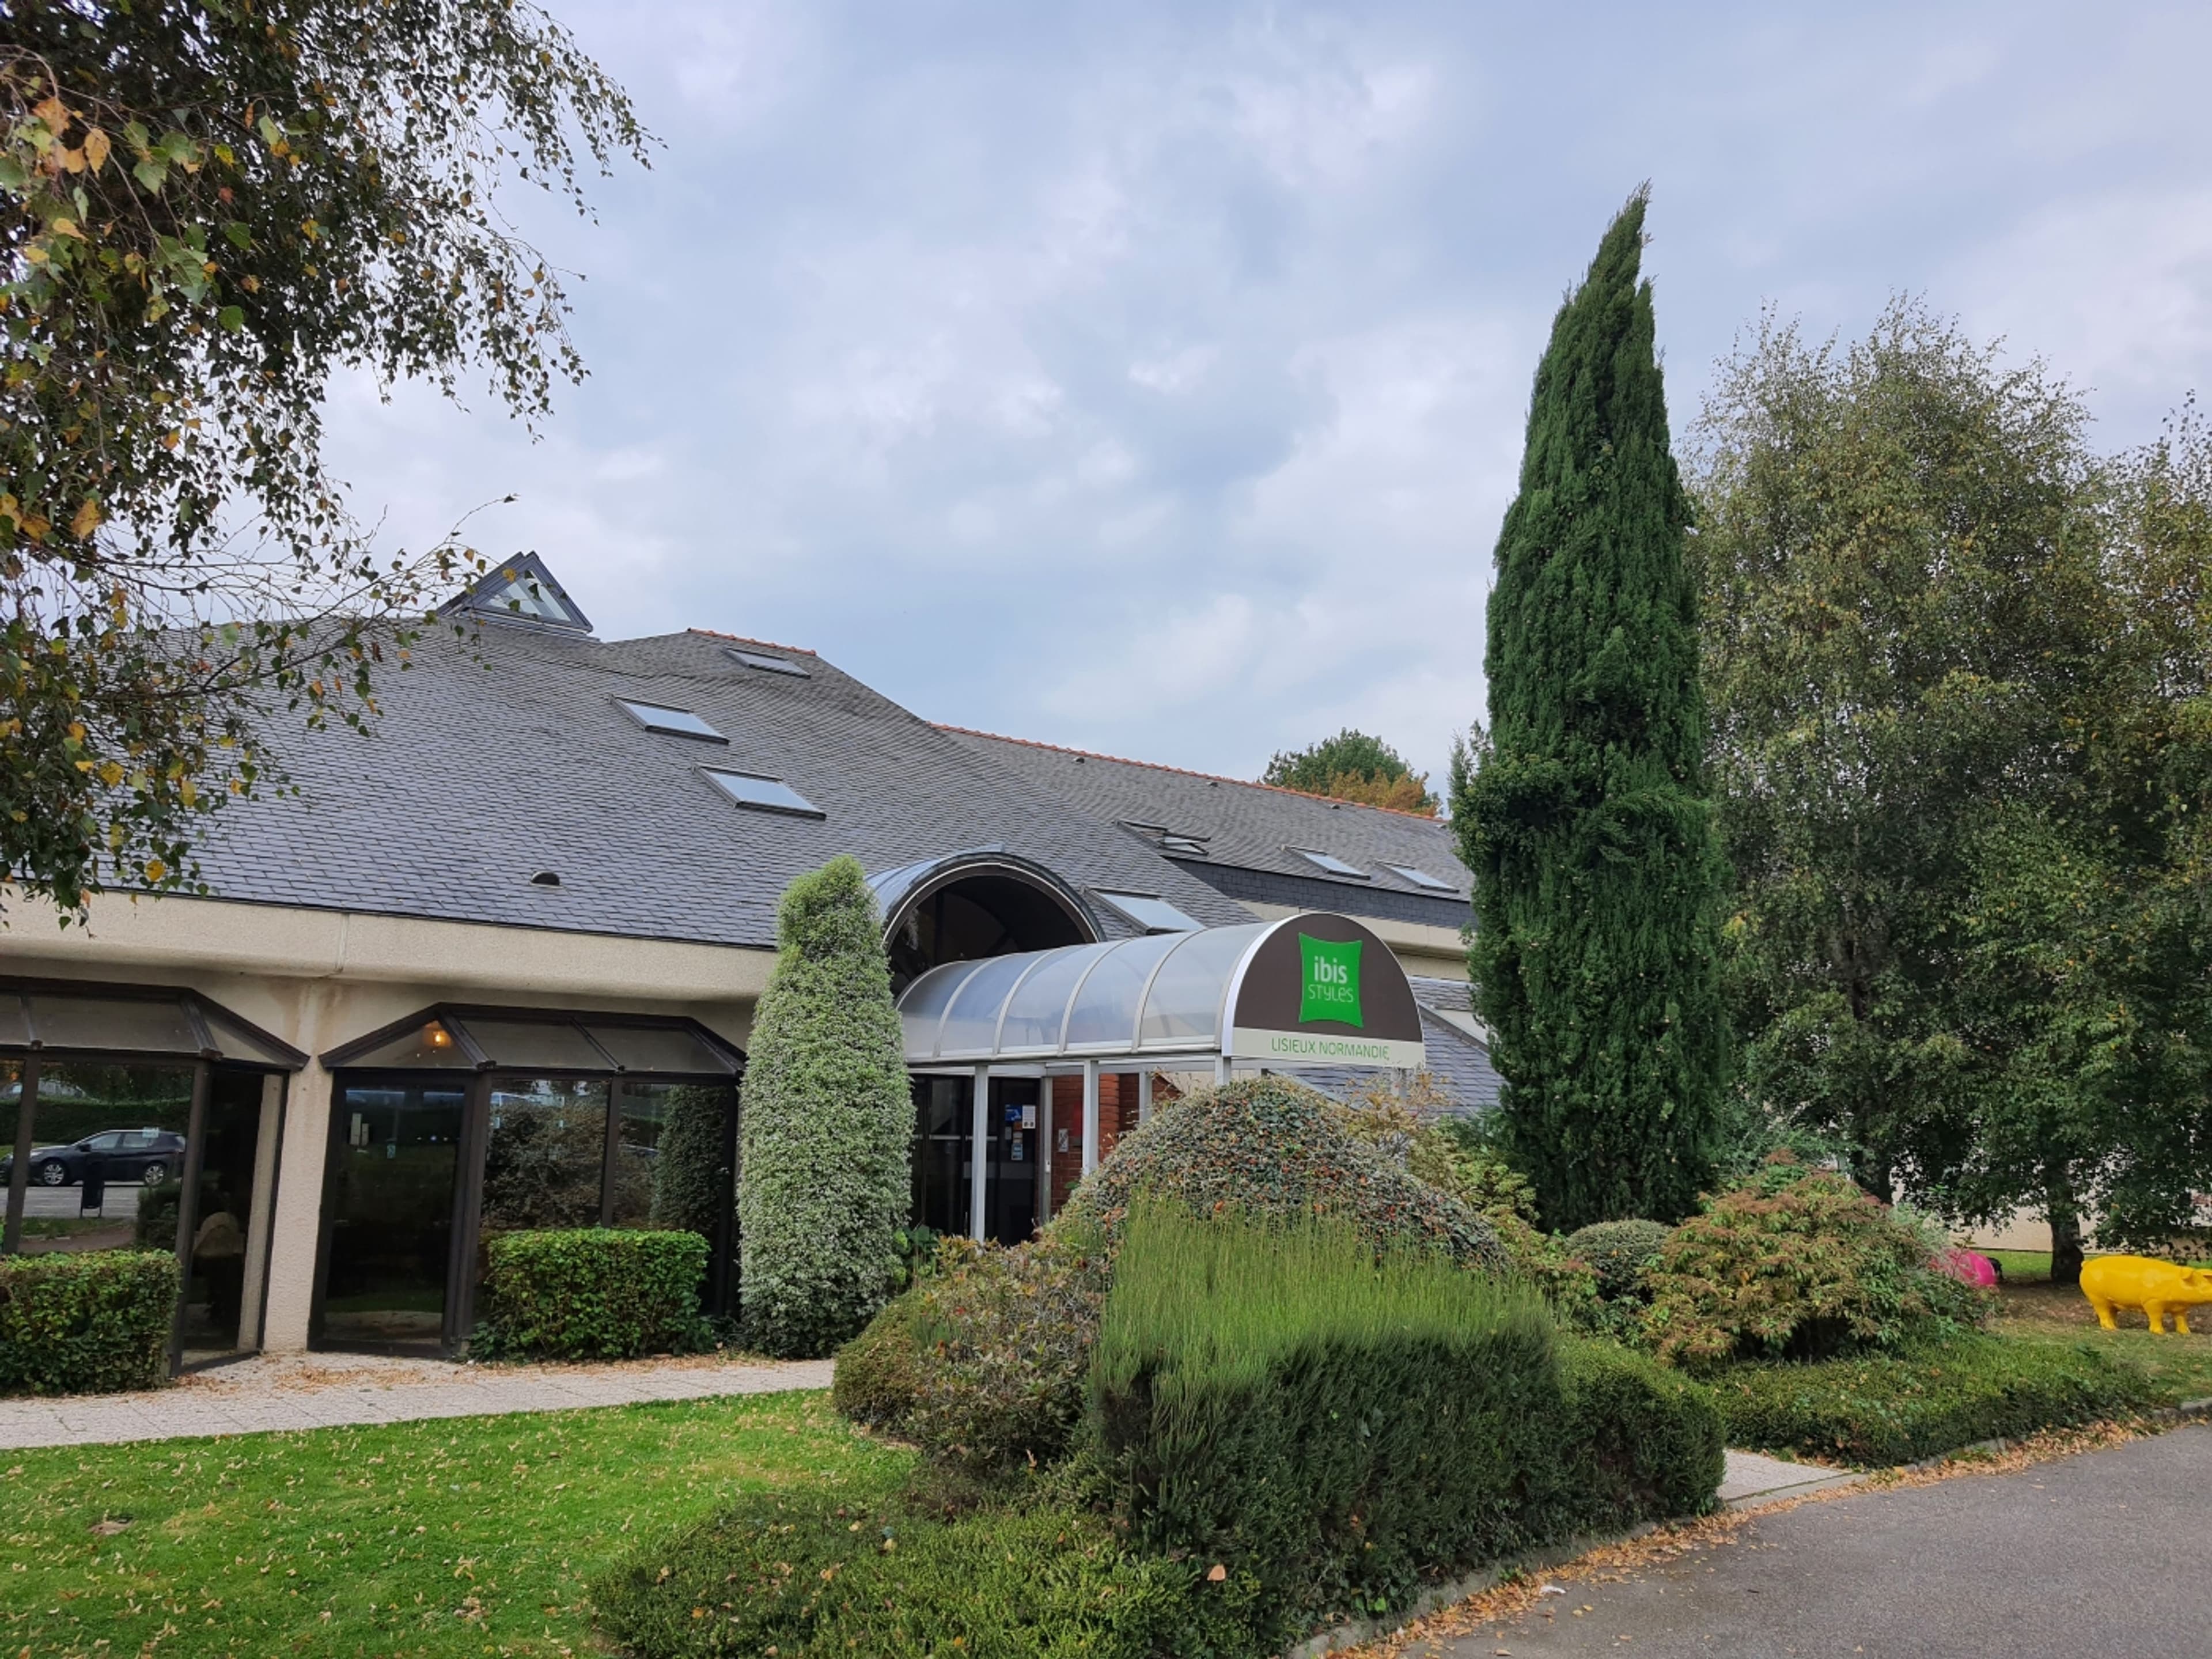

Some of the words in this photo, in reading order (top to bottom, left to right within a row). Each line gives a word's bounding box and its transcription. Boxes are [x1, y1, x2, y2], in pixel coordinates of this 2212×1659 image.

[1314, 955, 1347, 984] ibis
[1271, 1037, 1316, 1054] LISIEUX
[1319, 1041, 1390, 1060] NORMANDIE
